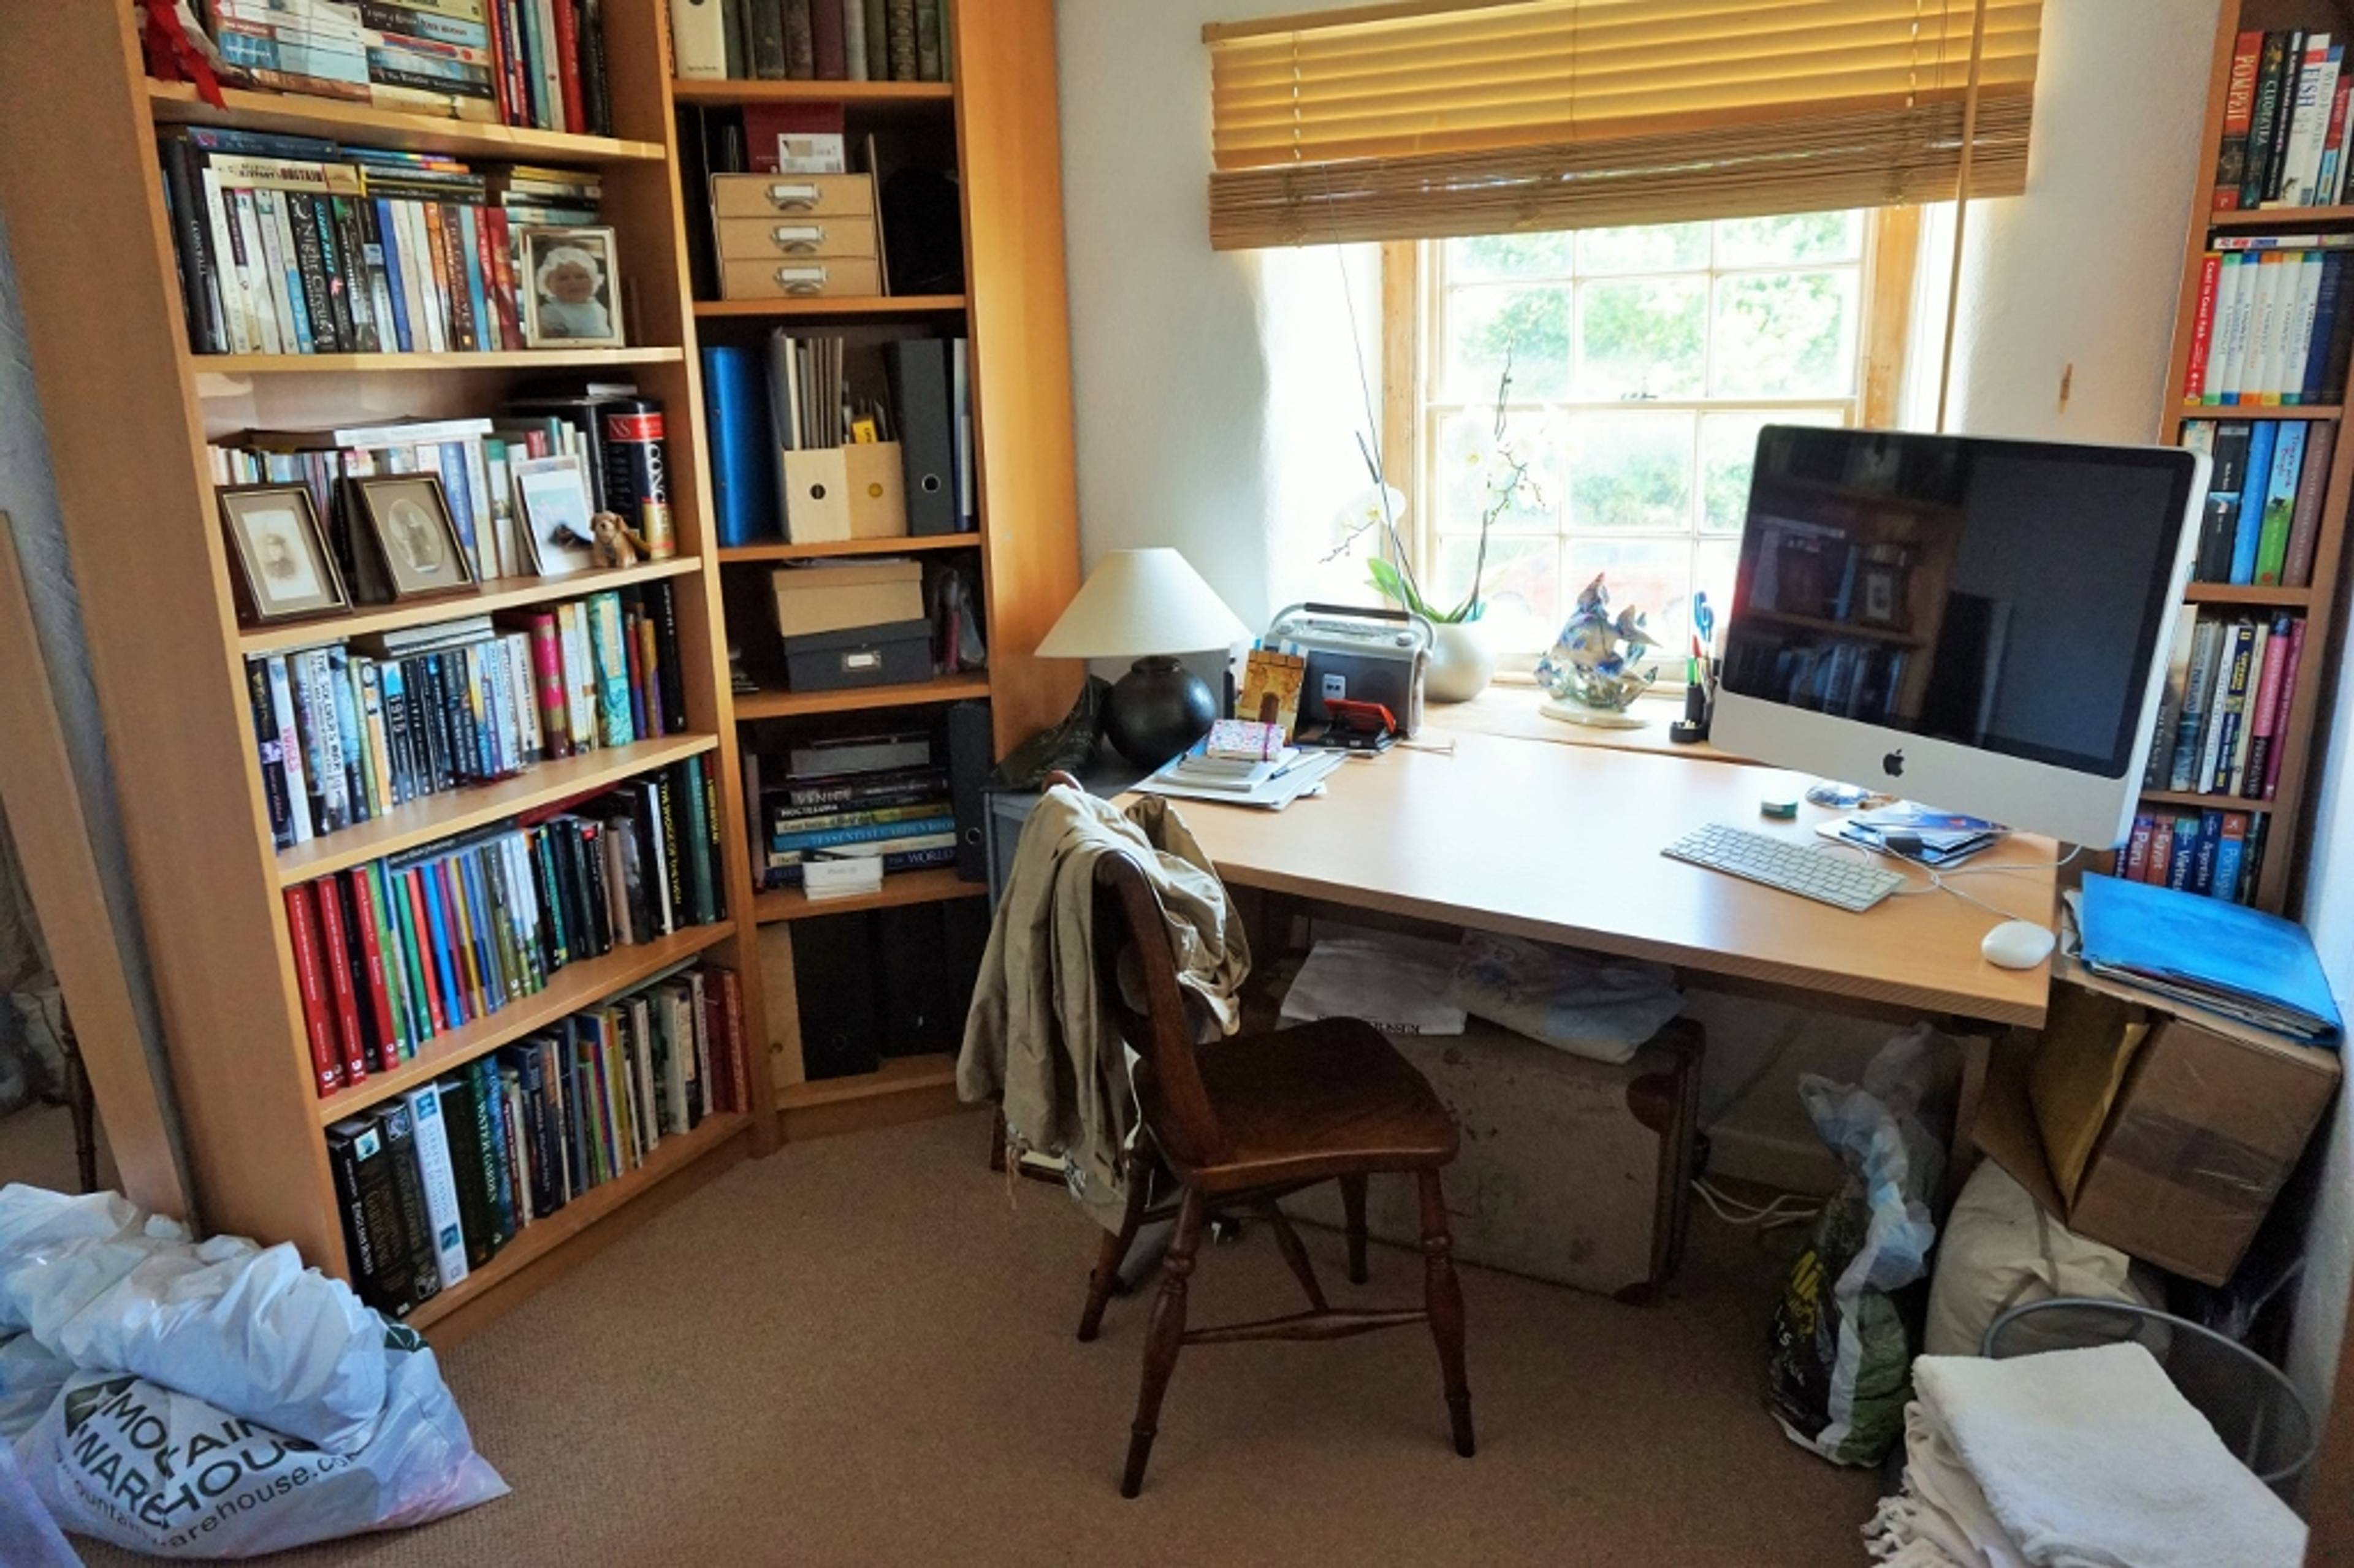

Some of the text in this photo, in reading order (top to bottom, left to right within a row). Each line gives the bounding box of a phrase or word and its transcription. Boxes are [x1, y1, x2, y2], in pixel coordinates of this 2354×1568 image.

[189, 219, 206, 275] CORNWALL
[646, 438, 667, 505] CONC
[390, 695, 406, 733] 1915
[907, 848, 954, 863] WORLD
[2130, 831, 2149, 866] Peru
[2173, 850, 2190, 891] Vietna
[101, 1391, 254, 1480] MOTAI
[72, 1423, 320, 1531] WAREHOU
